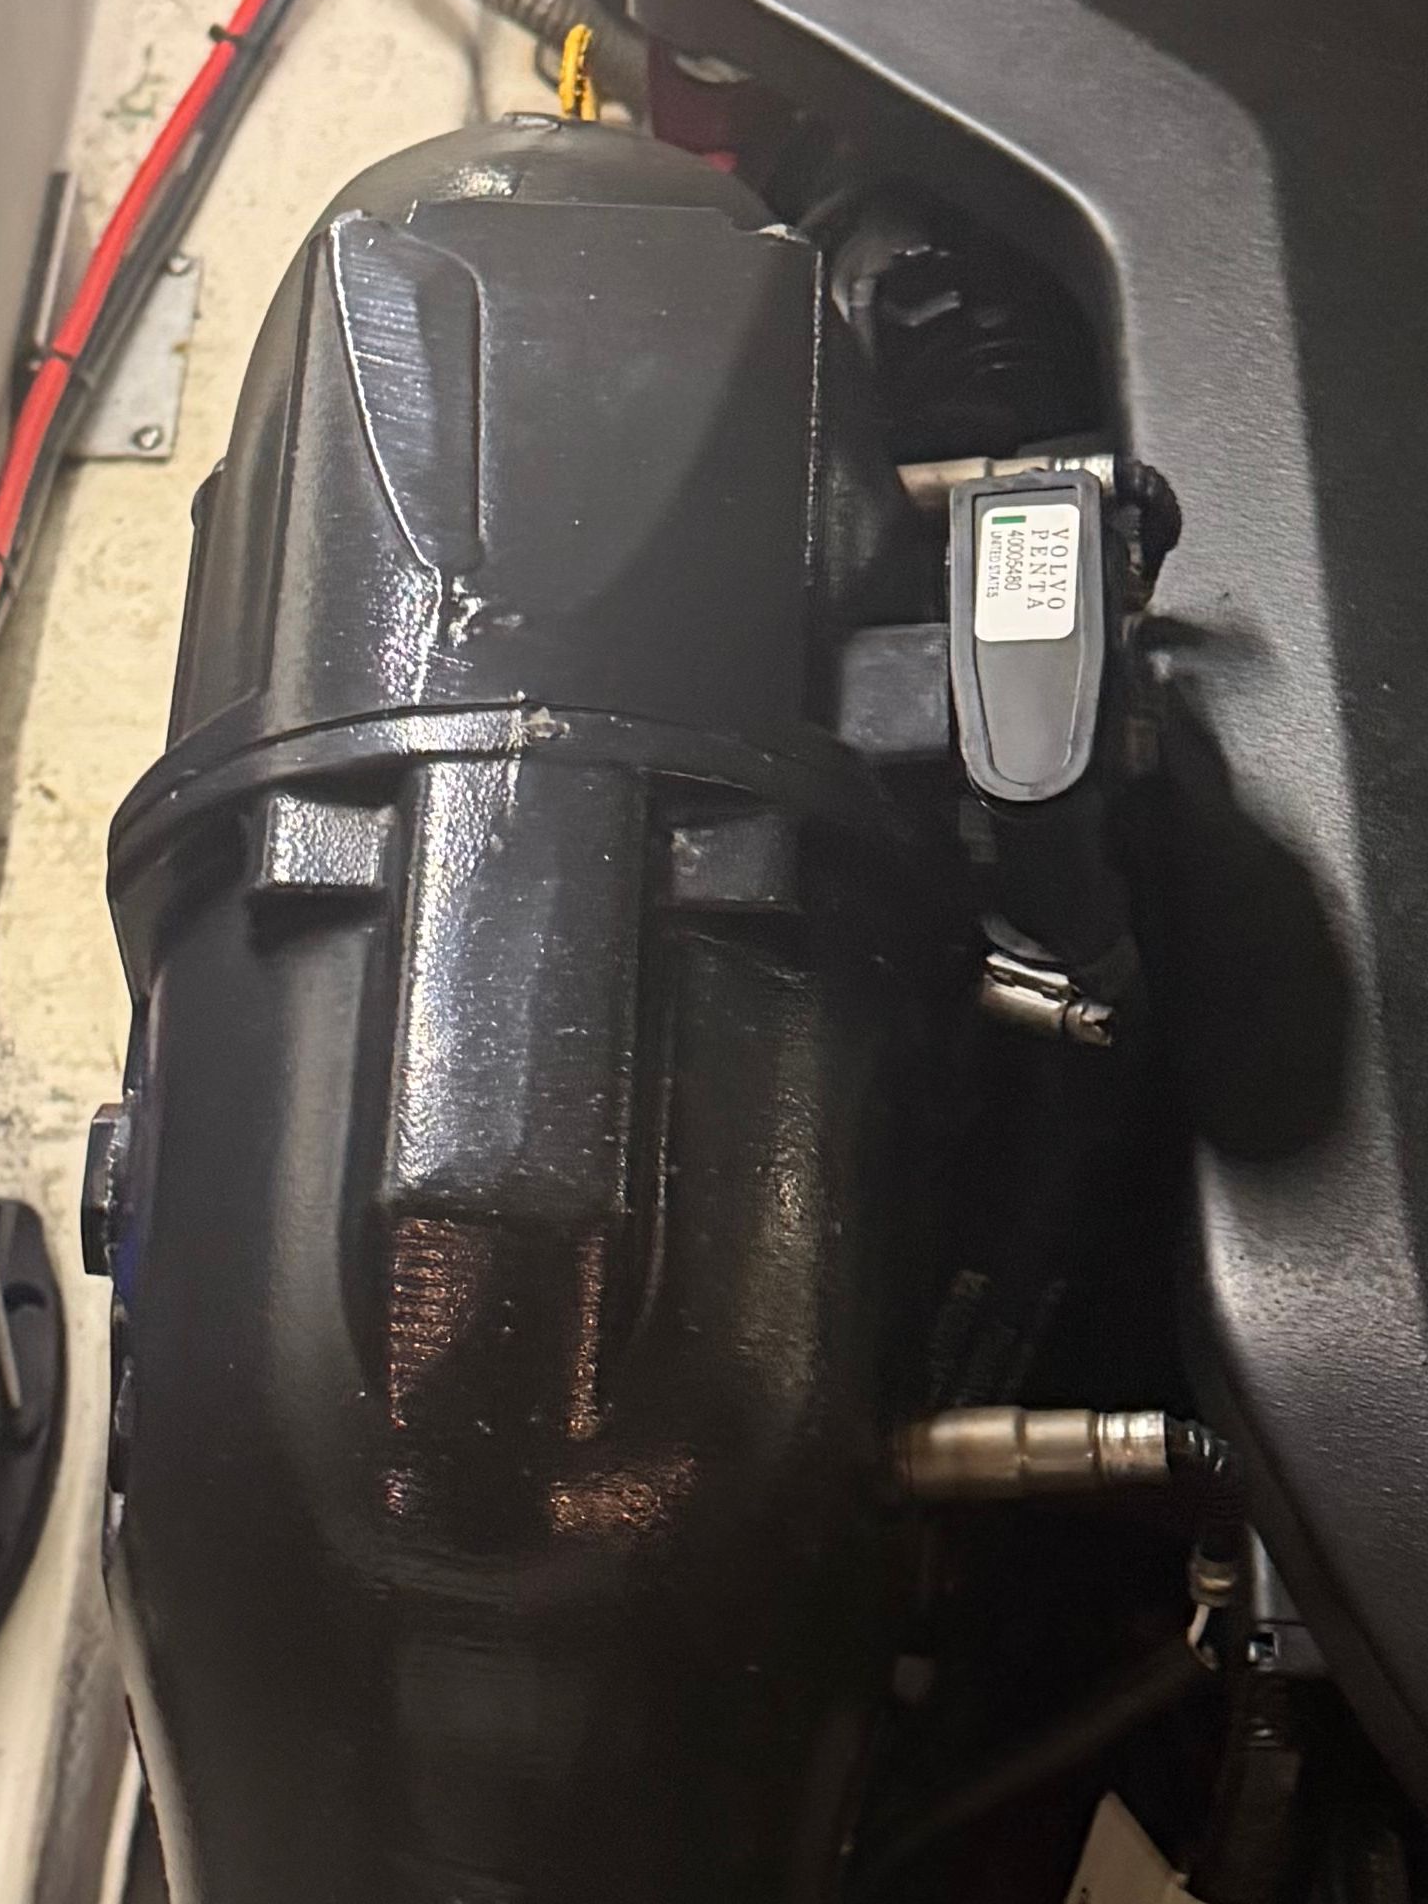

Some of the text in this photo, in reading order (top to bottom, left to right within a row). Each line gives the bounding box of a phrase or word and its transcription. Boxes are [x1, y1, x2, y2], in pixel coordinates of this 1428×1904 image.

[986, 530, 1003, 599] UNITED STATES
[1027, 529, 1050, 611] PENTA
[1047, 527, 1070, 611] VOLVO
